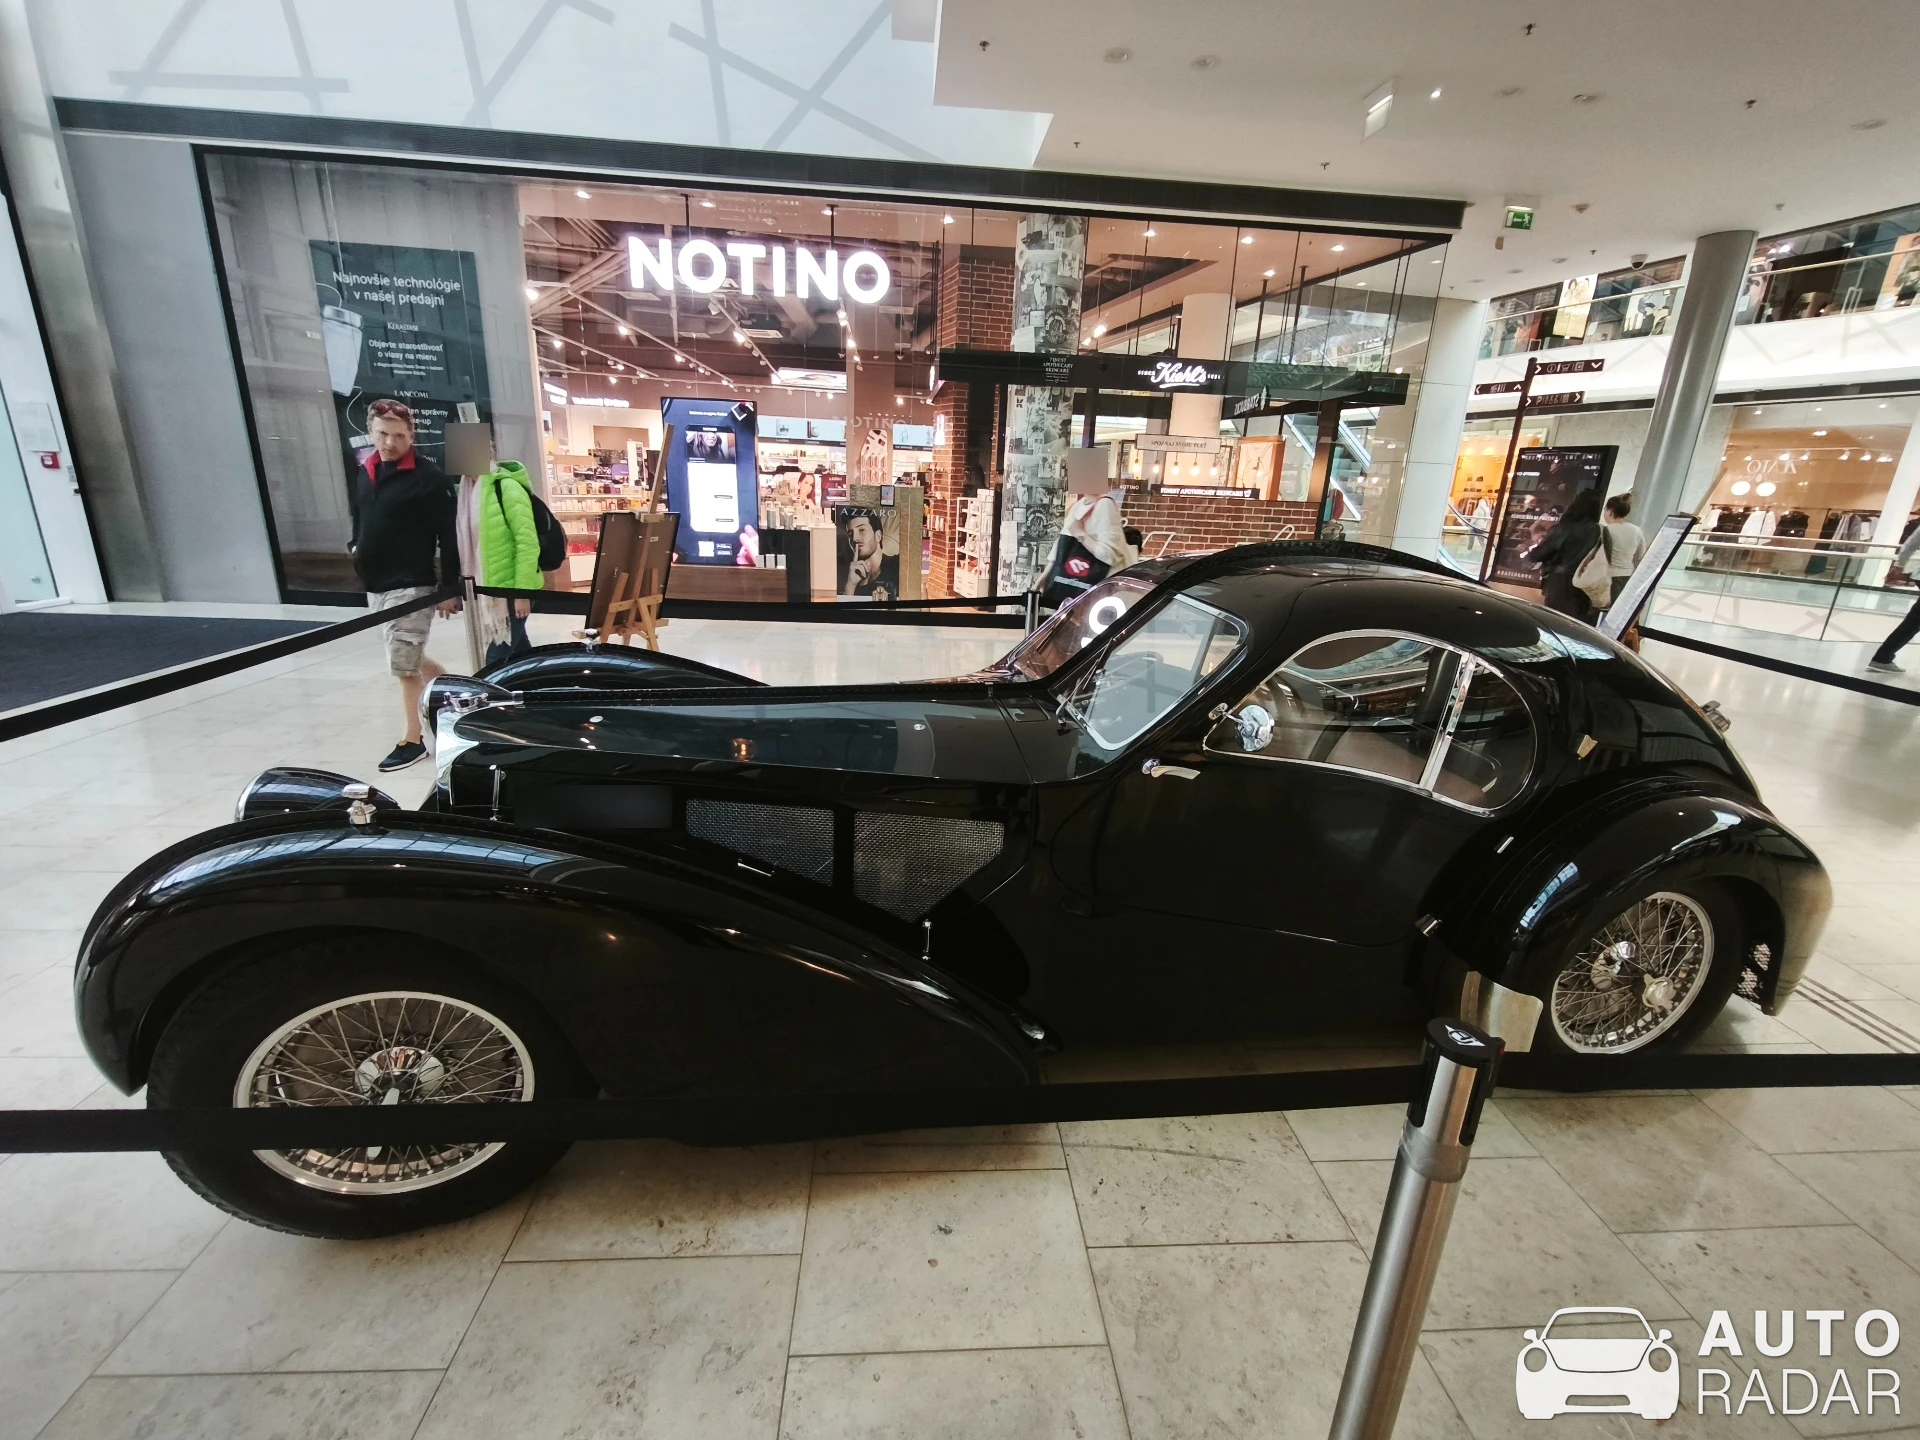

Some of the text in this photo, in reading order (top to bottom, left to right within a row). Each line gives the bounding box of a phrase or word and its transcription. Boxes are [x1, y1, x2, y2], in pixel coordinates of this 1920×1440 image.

[627, 235, 891, 304] NOTINO
[333, 271, 461, 293] Najnovšie technológie
[353, 290, 445, 308] v našej predajni
[368, 339, 397, 350] Objavte
[1151, 361, 1207, 385] Kiehl's
[840, 508, 897, 517] AZZARO
